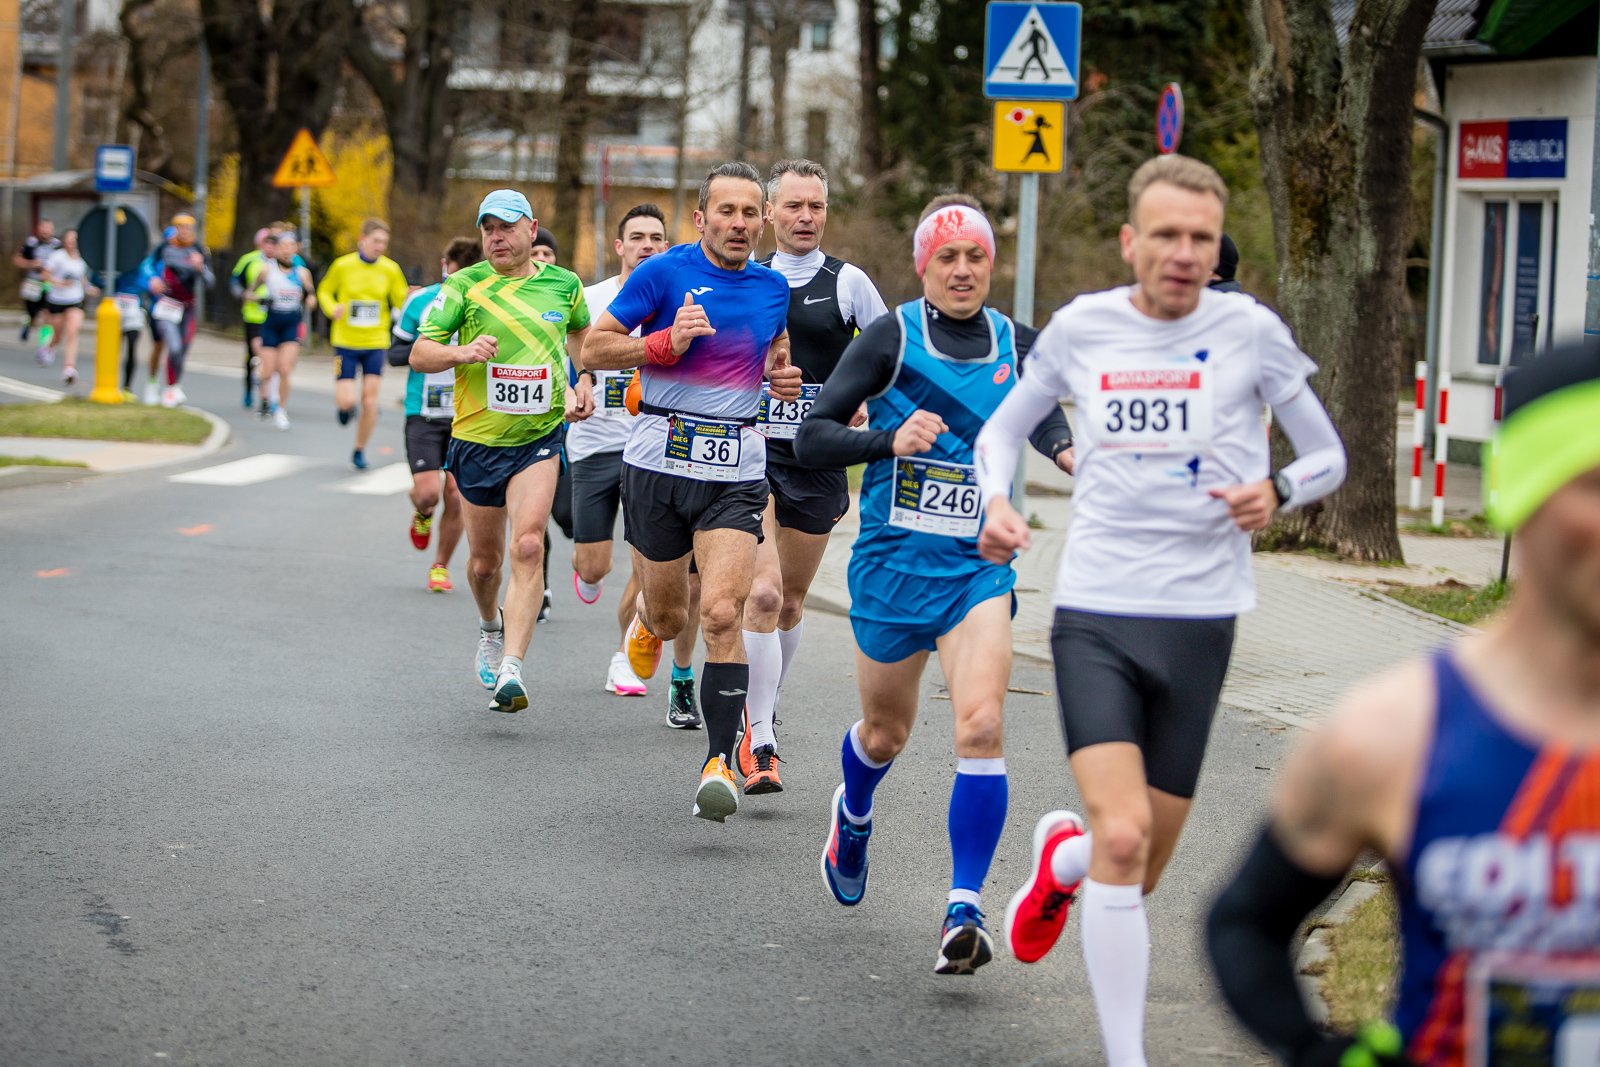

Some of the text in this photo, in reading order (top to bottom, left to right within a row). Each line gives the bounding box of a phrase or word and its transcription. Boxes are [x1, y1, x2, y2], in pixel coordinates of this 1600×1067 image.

[497, 368, 544, 378] DATASPORT
[495, 382, 544, 404] 3814
[1106, 398, 1188, 433] 3931
[672, 435, 689, 443] BIEG
[702, 439, 731, 462] 36
[923, 483, 976, 514] 246
